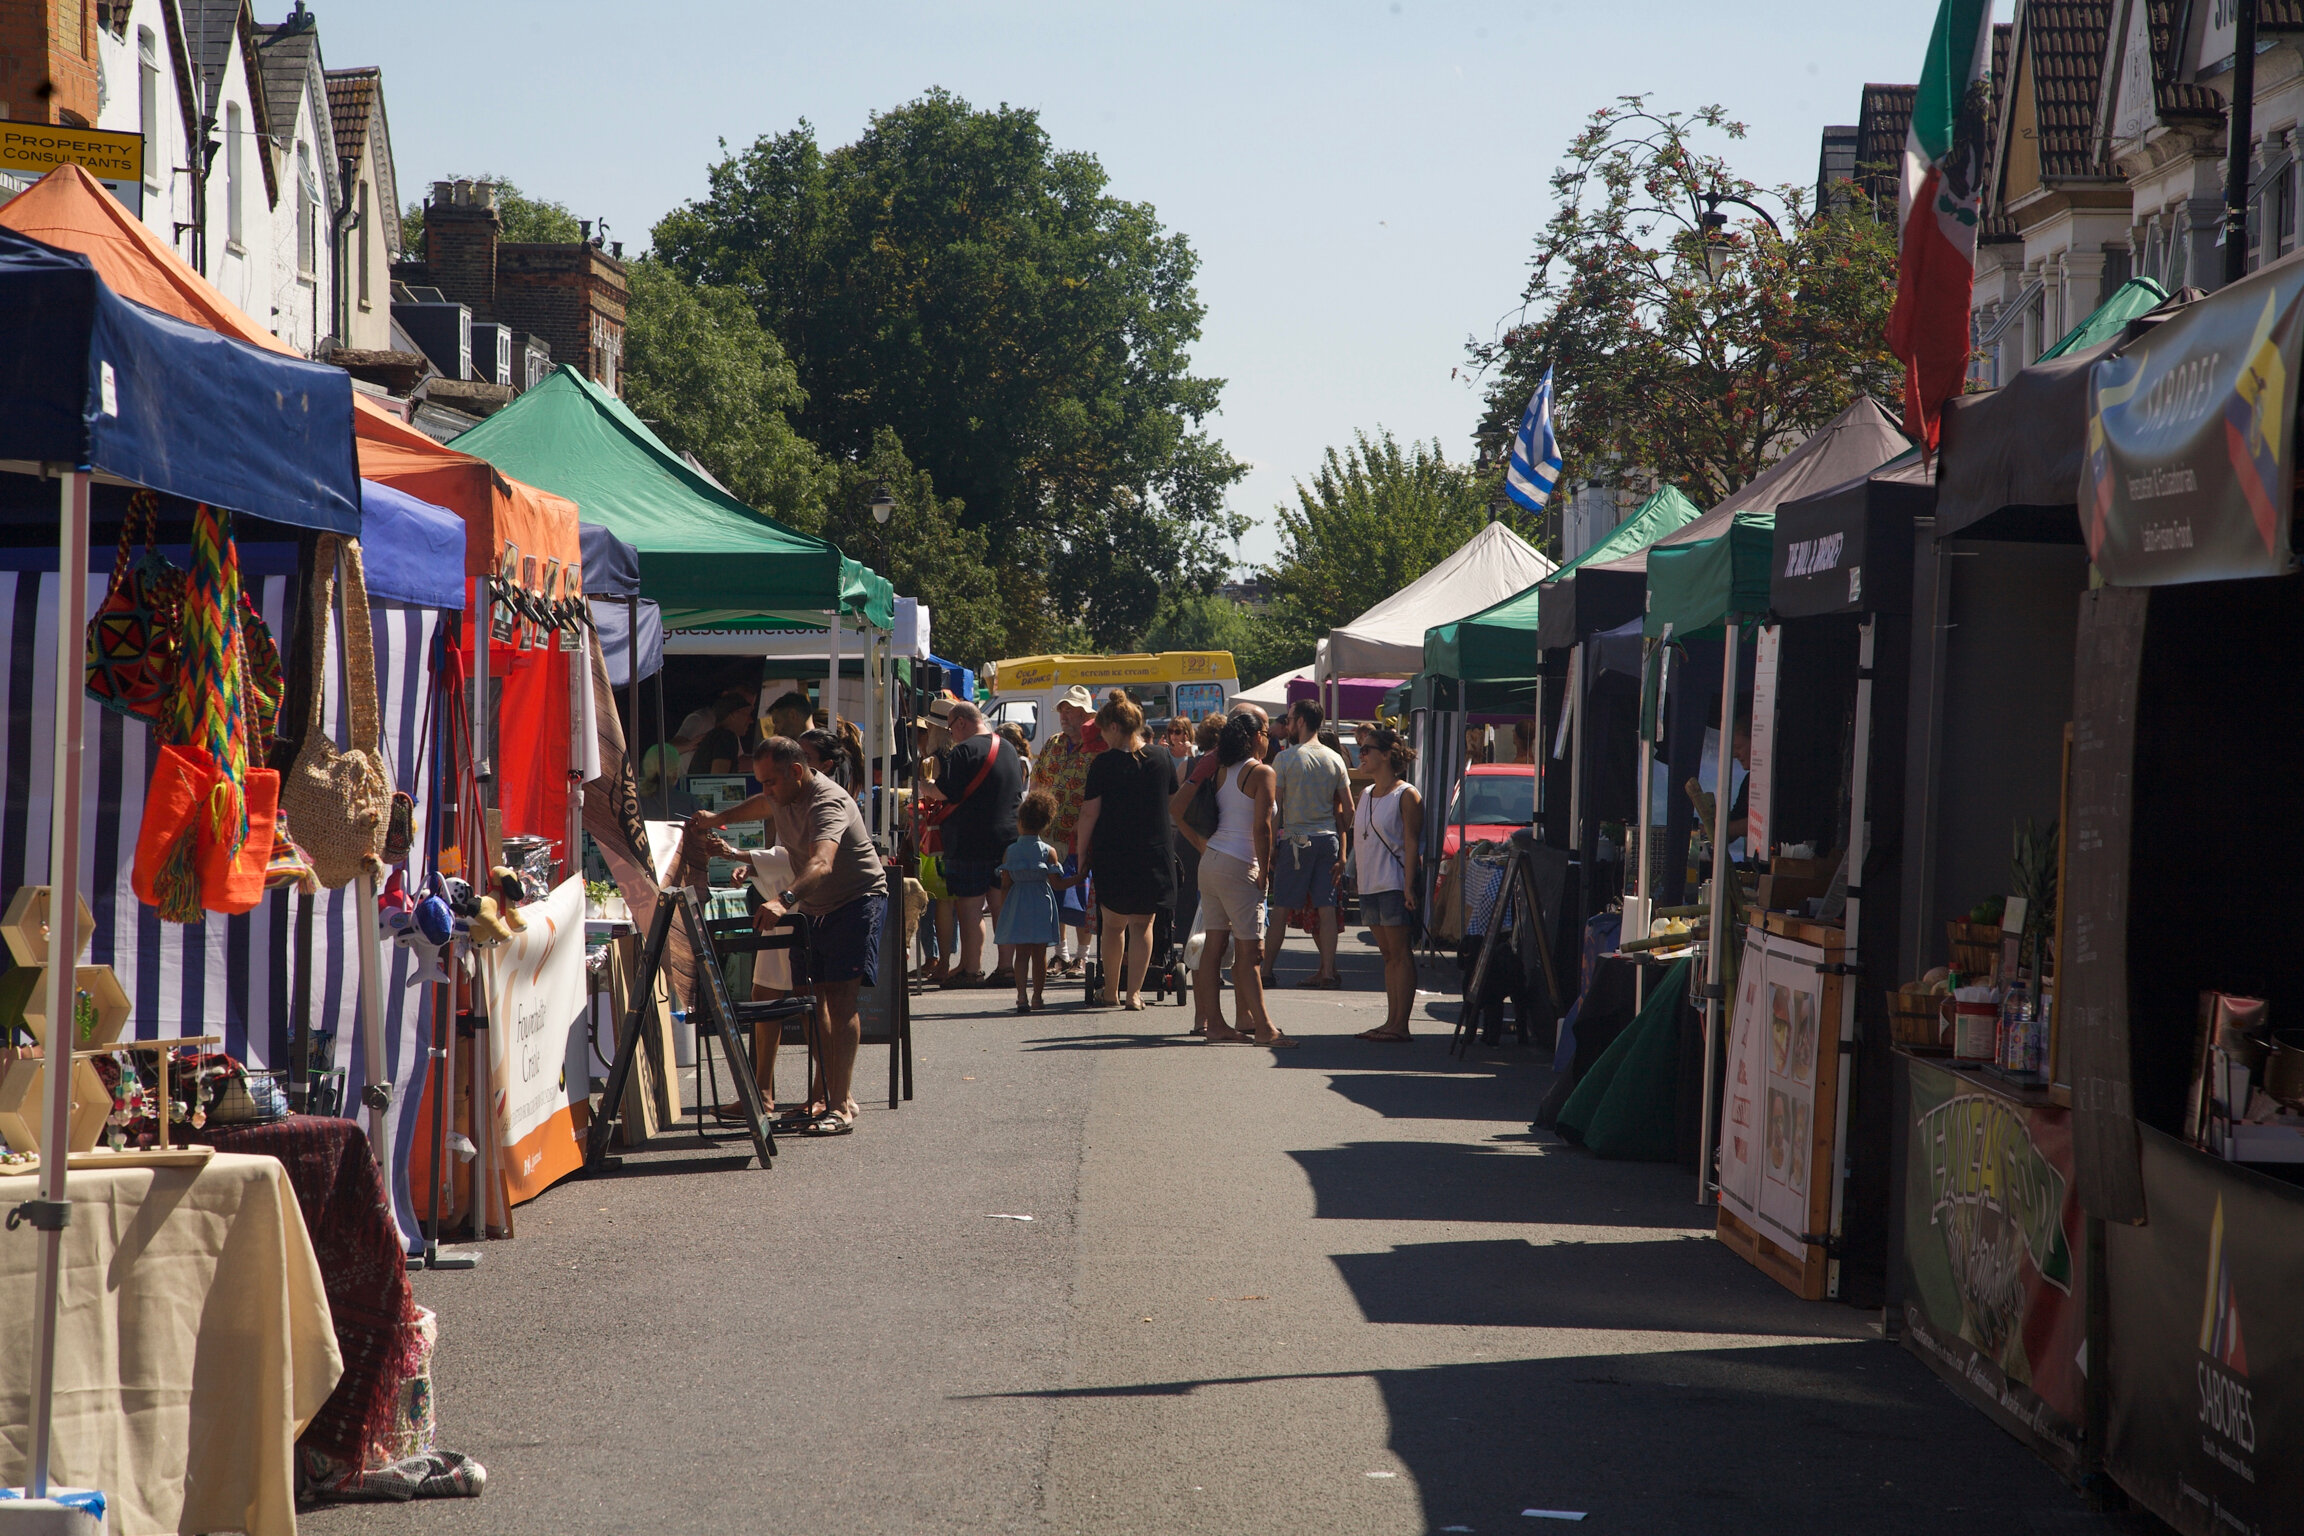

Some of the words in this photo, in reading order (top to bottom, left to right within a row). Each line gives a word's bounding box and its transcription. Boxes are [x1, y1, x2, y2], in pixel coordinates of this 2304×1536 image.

[4, 132, 133, 156] PROPERTY
[2135, 352, 2219, 435] SABORES
[1187, 655, 1206, 668] 99
[1015, 669, 1038, 680] COLD
[1021, 675, 1052, 687] DRINKS
[2197, 1360, 2255, 1454] SABORES
